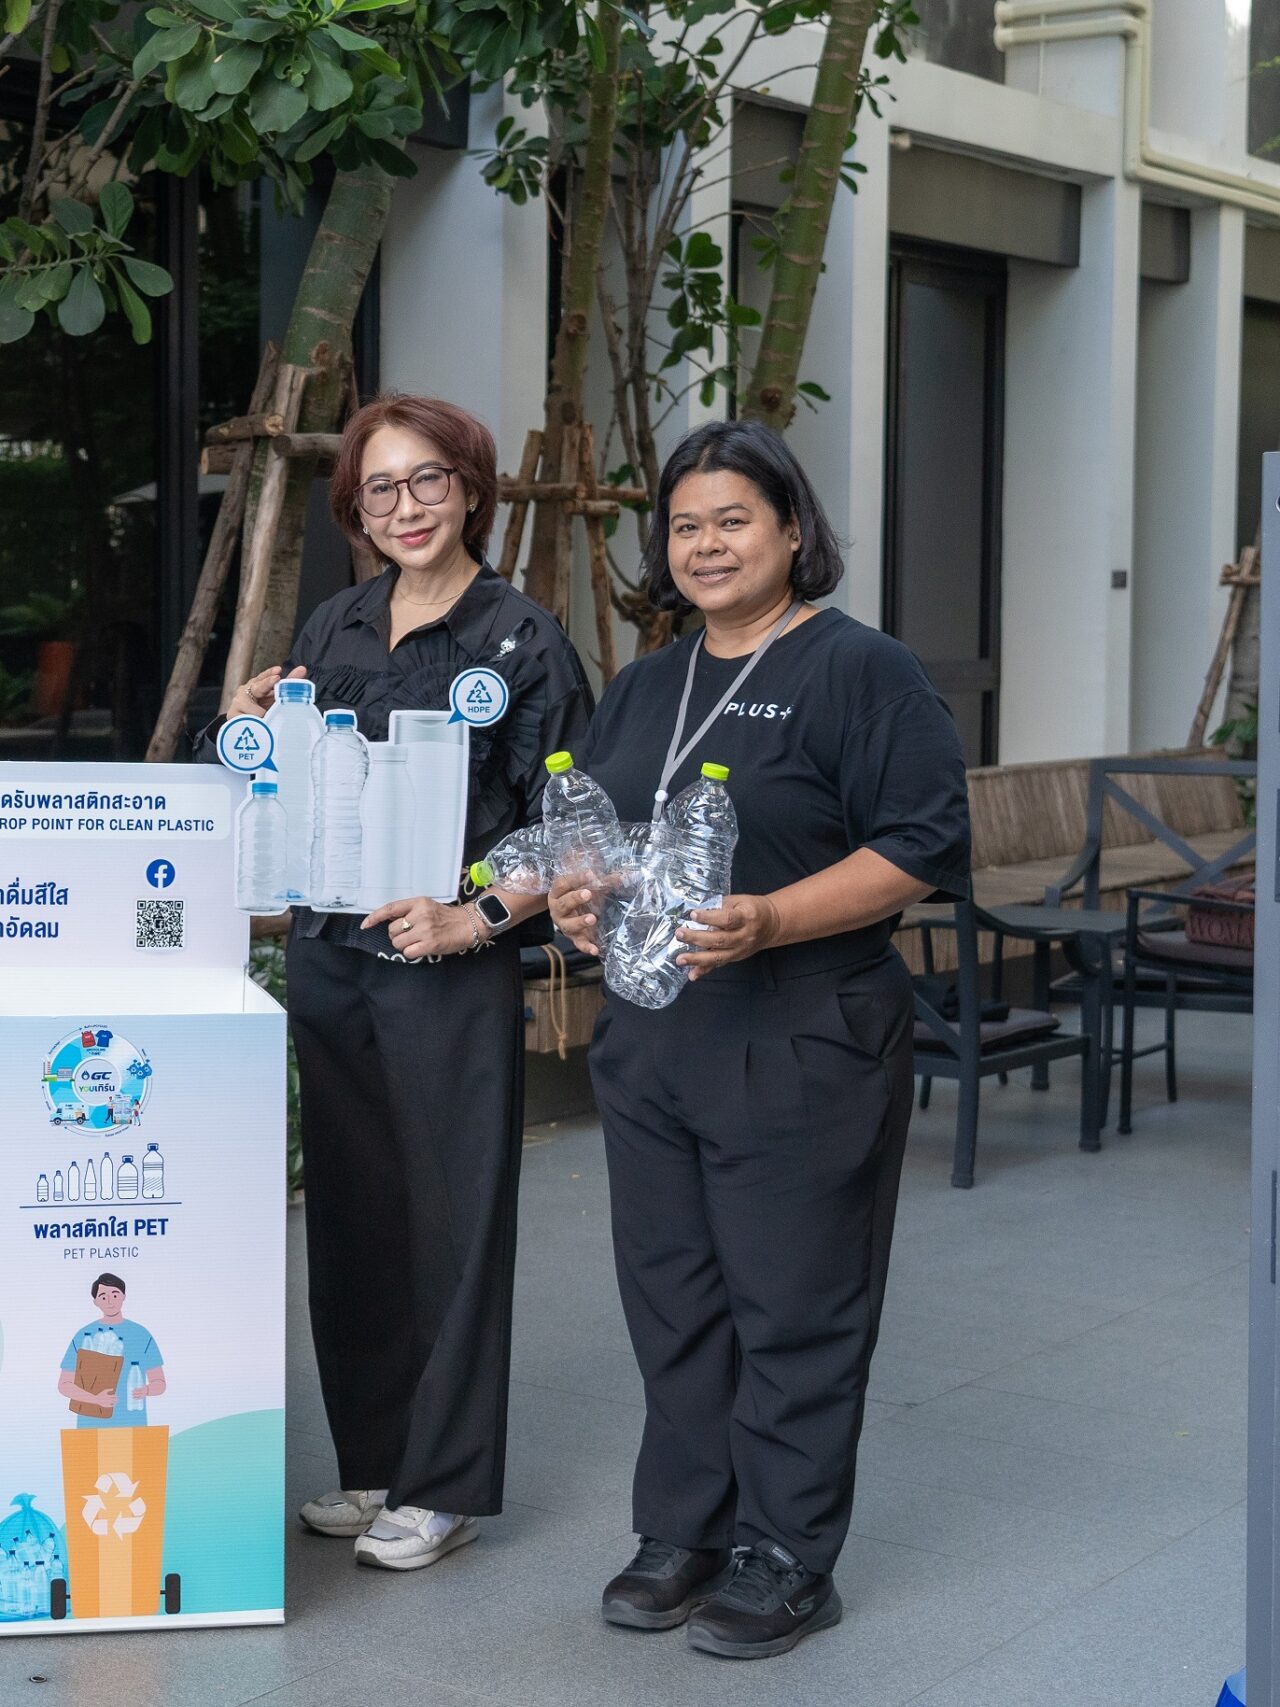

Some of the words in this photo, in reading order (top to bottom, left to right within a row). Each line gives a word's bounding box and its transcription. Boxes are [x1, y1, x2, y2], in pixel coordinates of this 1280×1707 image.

[467, 705, 491, 713] HDPE
[238, 752, 255, 761] PET
[31, 817, 74, 831] POINT
[77, 818, 105, 831] FOR
[109, 818, 153, 831] CLEAN
[157, 819, 215, 832] PLASTIC
[90, 1071, 113, 1081] GC
[33, 1215, 129, 1239] พลาสติกใส
[133, 1218, 169, 1237] PET
[63, 1247, 86, 1260] PET
[89, 1246, 140, 1260] PLASTIC
